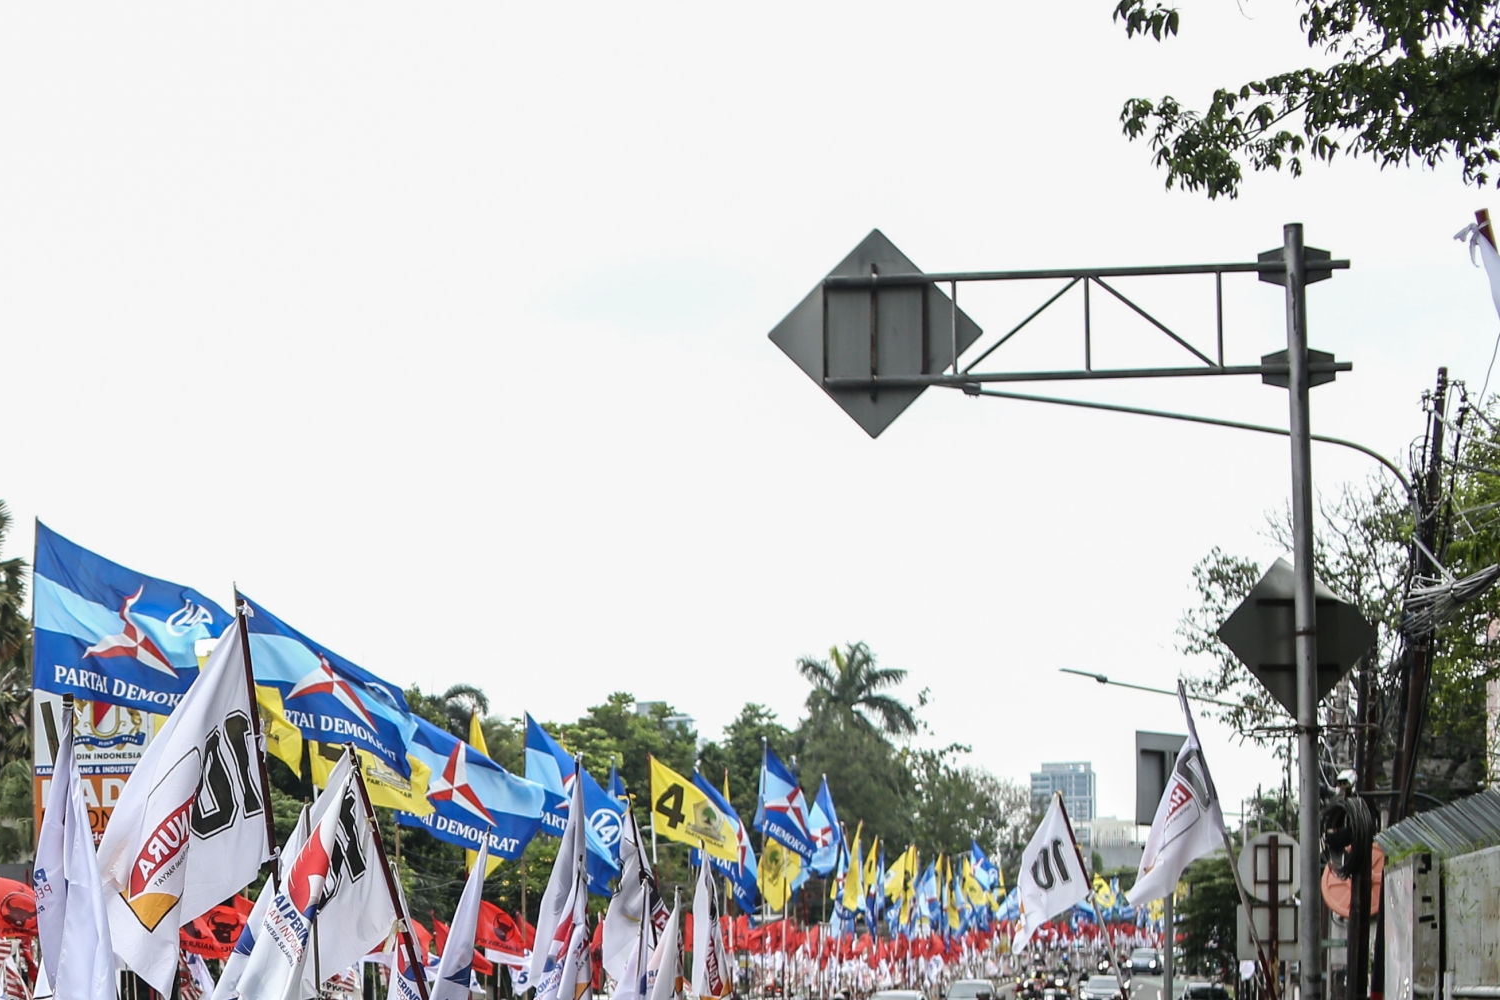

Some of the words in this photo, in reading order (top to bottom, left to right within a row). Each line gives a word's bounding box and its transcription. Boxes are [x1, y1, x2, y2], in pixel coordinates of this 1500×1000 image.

[54, 664, 109, 694] PARTAI
[94, 752, 142, 760] INDONESIA
[656, 784, 685, 829] 4
[769, 825, 813, 859] DEMOKRA
